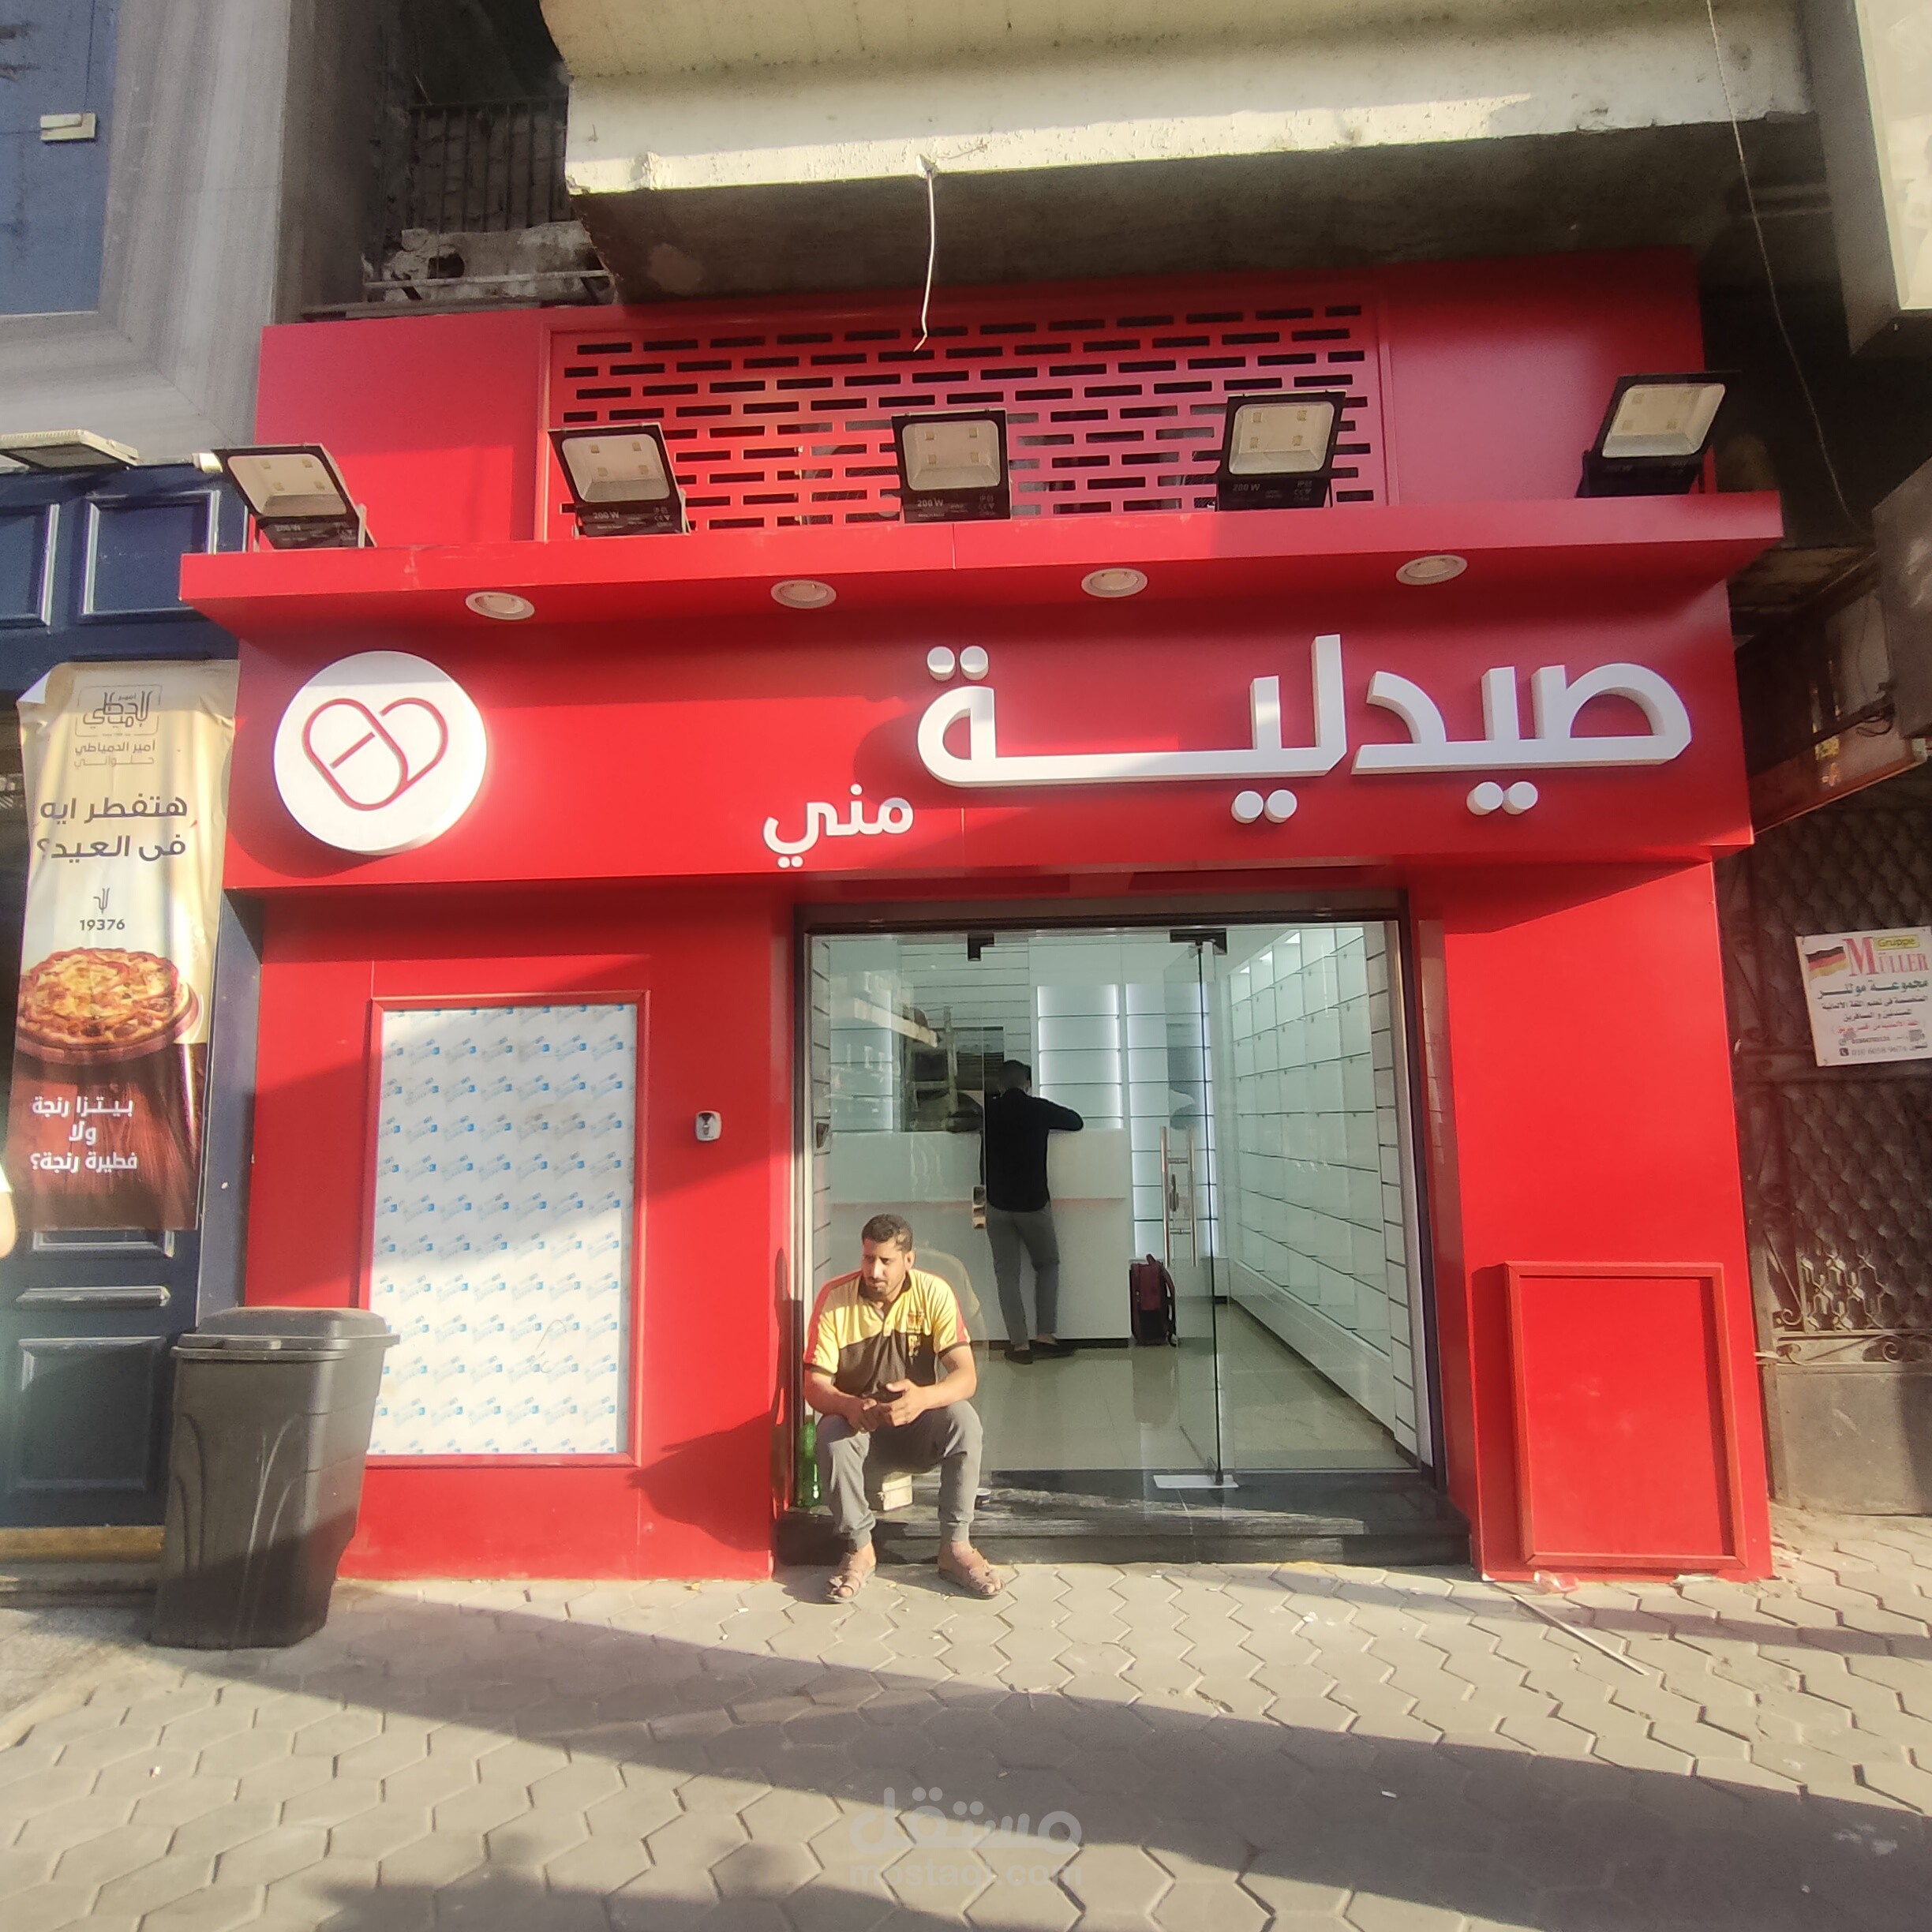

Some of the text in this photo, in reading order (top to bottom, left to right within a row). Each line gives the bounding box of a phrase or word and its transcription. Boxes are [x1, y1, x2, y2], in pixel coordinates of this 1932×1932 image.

[934, 498, 944, 507] W
[918, 634, 1692, 824] صيدلية
[39, 797, 77, 825] ايه
[763, 784, 914, 868] مني
[36, 835, 131, 863] العيد؟
[80, 919, 125, 931] 19376
[1877, 938, 1916, 948] Gruppe
[32, 1095, 133, 1118] بيتزا رنجة
[68, 1120, 97, 1146] ولا
[29, 1151, 138, 1174] فطيرة رنجة؟
